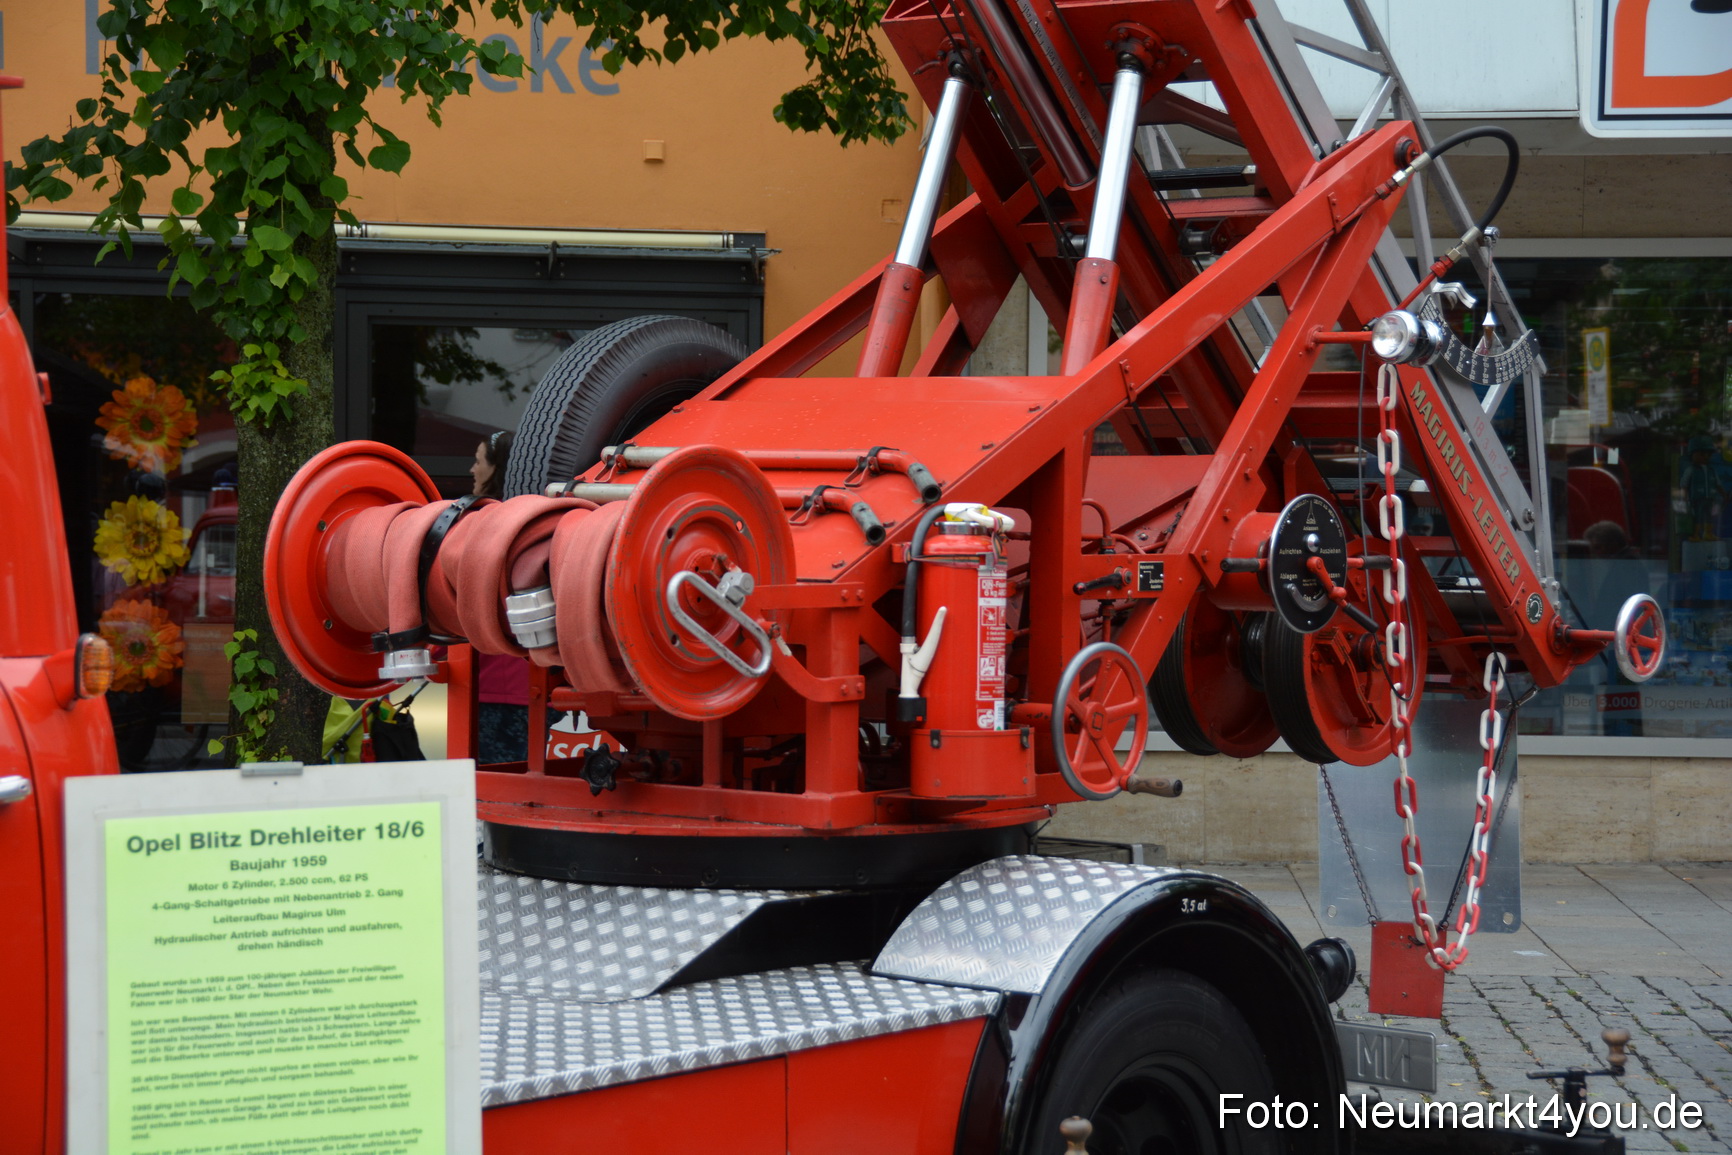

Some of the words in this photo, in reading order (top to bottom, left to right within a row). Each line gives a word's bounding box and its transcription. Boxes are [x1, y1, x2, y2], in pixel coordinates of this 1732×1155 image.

[1410, 380, 1520, 586] MAGIRUS-LEITER
[1598, 696, 1638, 708] 3.000
[126, 834, 181, 857] Opel
[190, 830, 242, 850] Blitz
[250, 824, 366, 847] Drehleiter
[375, 821, 425, 840] 18/6
[230, 857, 287, 874] Baujahr
[292, 855, 328, 868] 1959
[188, 882, 219, 892] Motor
[222, 881, 229, 890] 6
[231, 878, 277, 891] Zylinder,
[279, 877, 309, 887] 2.500
[311, 877, 337, 886] ccm,
[338, 874, 352, 883] 62
[354, 873, 369, 882] PS
[152, 896, 271, 913] 4-Gang-Schaltgetriebe
[273, 895, 290, 904] mit
[293, 891, 362, 902] Nebenantrieb
[364, 889, 375, 898] 2.
[377, 888, 404, 899] Gang
[213, 912, 279, 924] Leiteraufbau
[281, 909, 324, 921] Magirus
[326, 908, 346, 917] Ulm
[154, 932, 228, 946] Hydraulischer
[230, 930, 269, 940] Antrieb
[271, 926, 325, 937] aufrichten
[327, 924, 347, 934] und
[349, 921, 403, 932] ausfahren,
[237, 942, 274, 952] drehen
[276, 938, 324, 949] händisch
